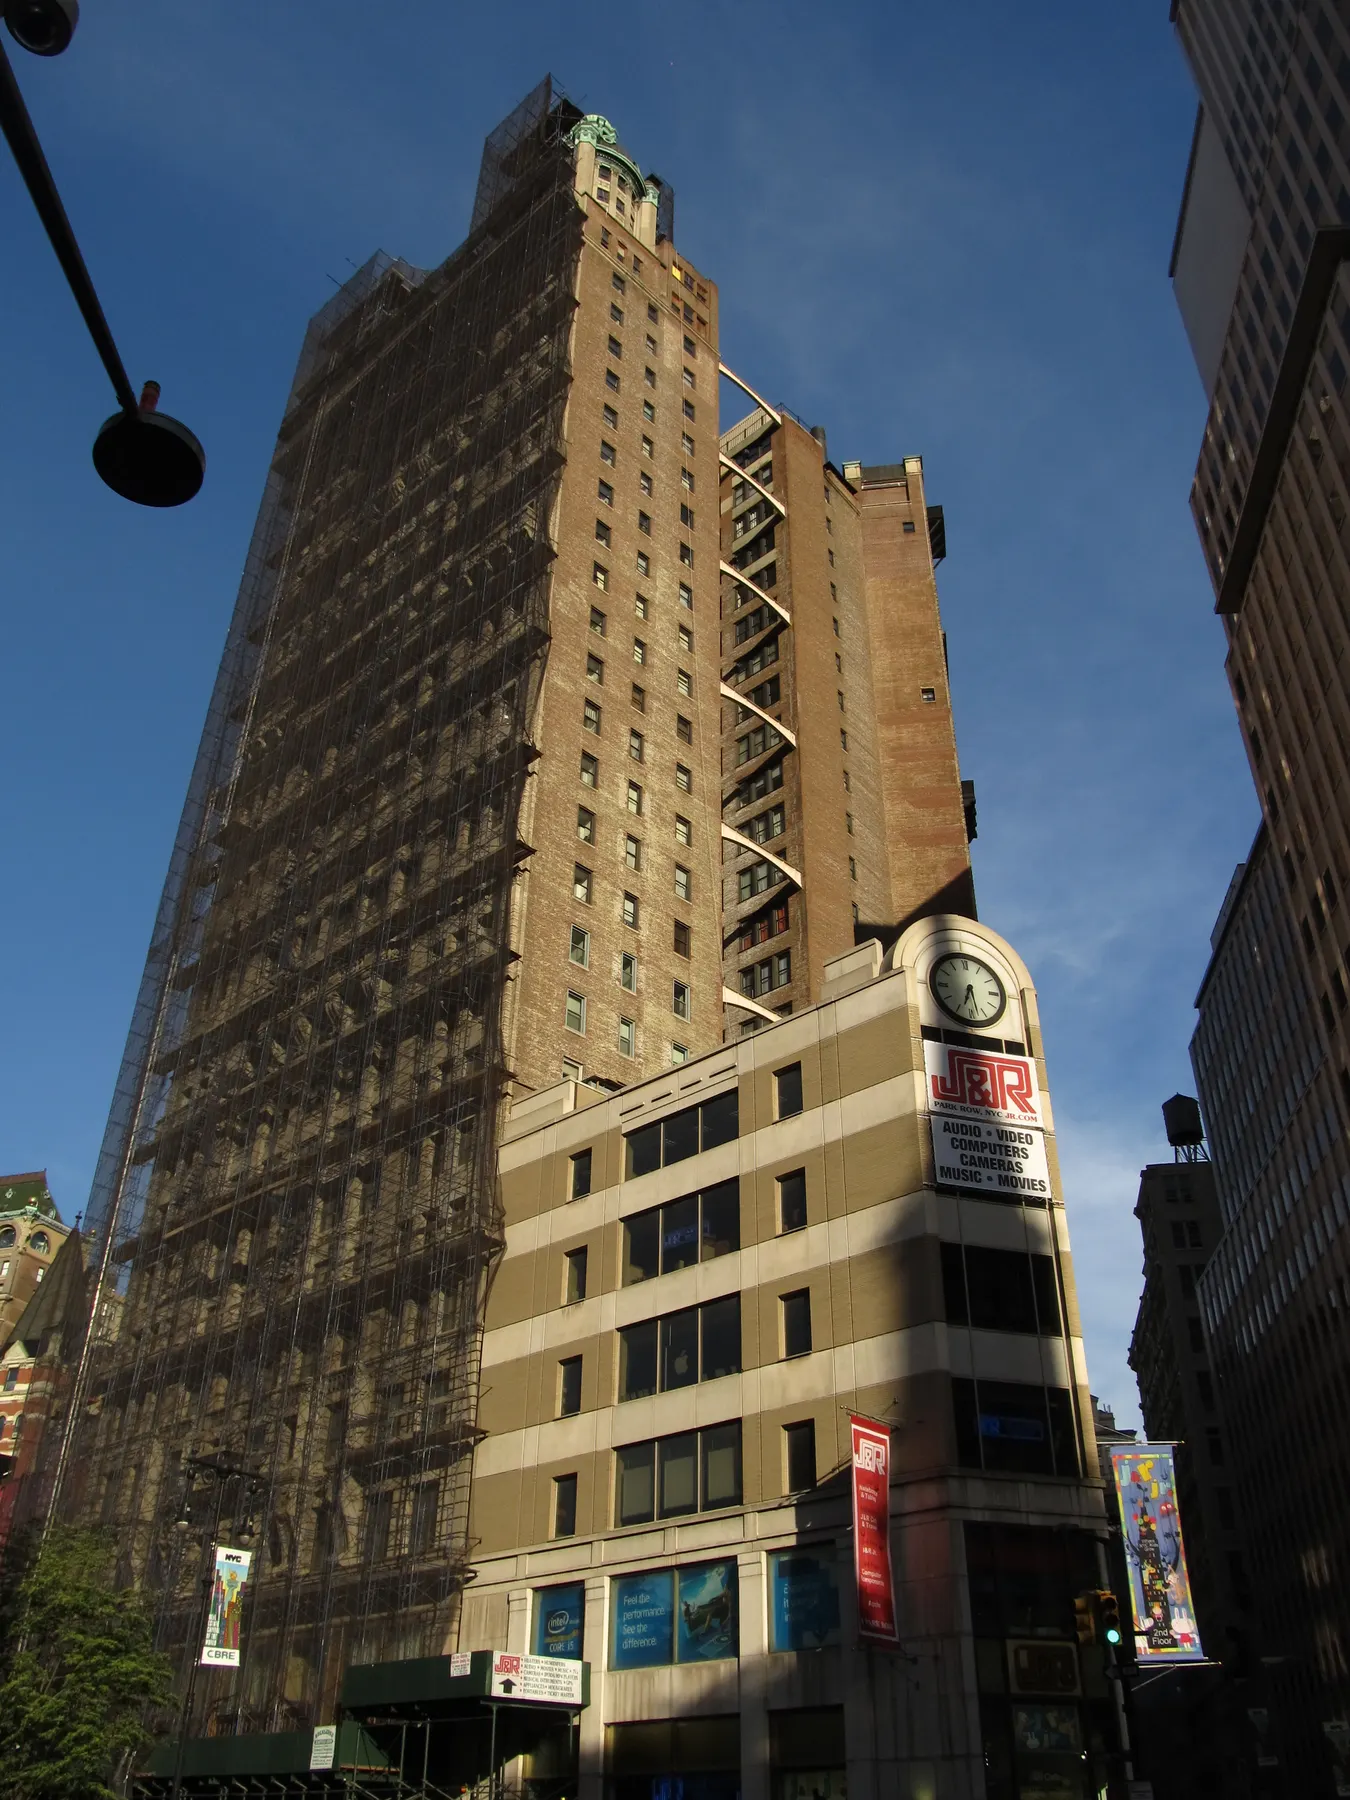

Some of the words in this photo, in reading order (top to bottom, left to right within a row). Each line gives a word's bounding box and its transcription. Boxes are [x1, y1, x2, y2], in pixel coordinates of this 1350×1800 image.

[931, 1049, 1036, 1114] J&R
[934, 1101, 958, 1111] PARK
[960, 1105, 983, 1115] ROW,
[985, 1109, 1003, 1118] NYC
[1005, 1113, 1038, 1122] JR.COM
[943, 1121, 982, 1138] AUDIO
[996, 1129, 1034, 1145] VIDEO
[951, 1137, 1029, 1160] COMPUTERS
[960, 1154, 1024, 1174] CAMERAS
[940, 1166, 982, 1184] MUSIC
[998, 1174, 1047, 1192] MOVIES
[854, 1438, 885, 1475] J&R
[225, 1553, 242, 1563] NYC
[623, 1595, 638, 1606] Feel
[638, 1593, 650, 1604] the
[623, 1624, 636, 1635] See
[636, 1622, 648, 1634] the
[1152, 1637, 1172, 1645] Floor
[207, 1649, 235, 1660] CBRE
[495, 1655, 520, 1674] J&R
